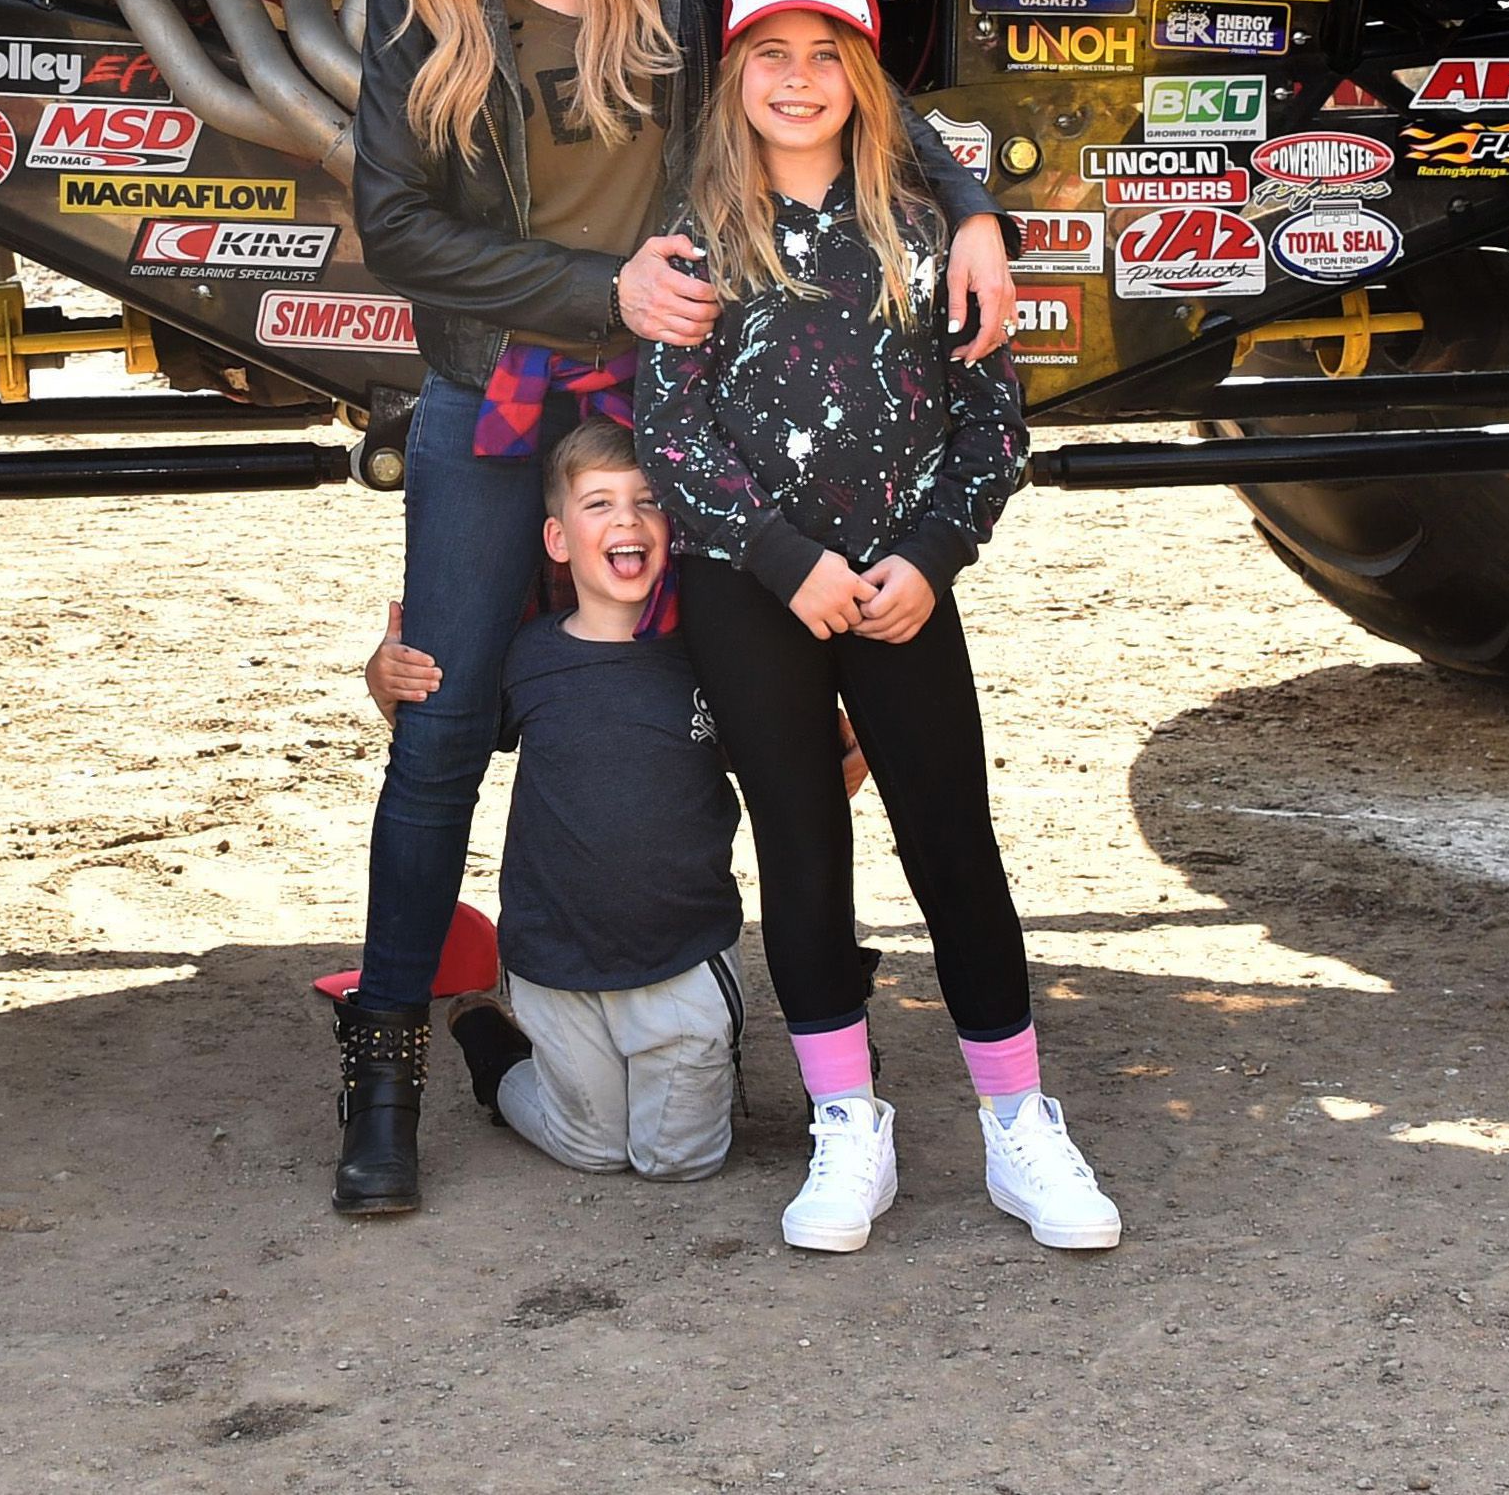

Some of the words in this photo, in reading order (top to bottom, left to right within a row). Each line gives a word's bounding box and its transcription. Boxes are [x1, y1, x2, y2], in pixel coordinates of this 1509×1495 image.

[1215, 13, 1274, 31] ENERGY
[1007, 21, 1136, 64] UNOH
[1215, 30, 1275, 47] RELEASE
[1150, 88, 1258, 116] BKT
[41, 107, 195, 152] MSD
[1146, 130, 1197, 138] GROWING
[1200, 129, 1257, 137] TOGETHER
[30, 155, 59, 165] PRO
[60, 156, 92, 166] MAG
[1090, 150, 1218, 175] LINCOLN
[1268, 140, 1376, 177] POWERMASTER
[66, 181, 288, 211] MAGNAFLOW
[1118, 181, 1233, 201] WELDERS
[1254, 181, 1390, 211] Performance
[216, 231, 326, 259] KING
[1120, 209, 1261, 263] JAZ
[1285, 231, 1339, 254] TOTAL
[1342, 230, 1388, 253] SEAL
[1303, 257, 1338, 266] PISTON
[1340, 256, 1369, 265] RINGS
[130, 265, 177, 277] ENGINE
[180, 267, 236, 279] BEARING
[239, 269, 317, 282] SPECIALISTS
[1127, 262, 1255, 286] Products
